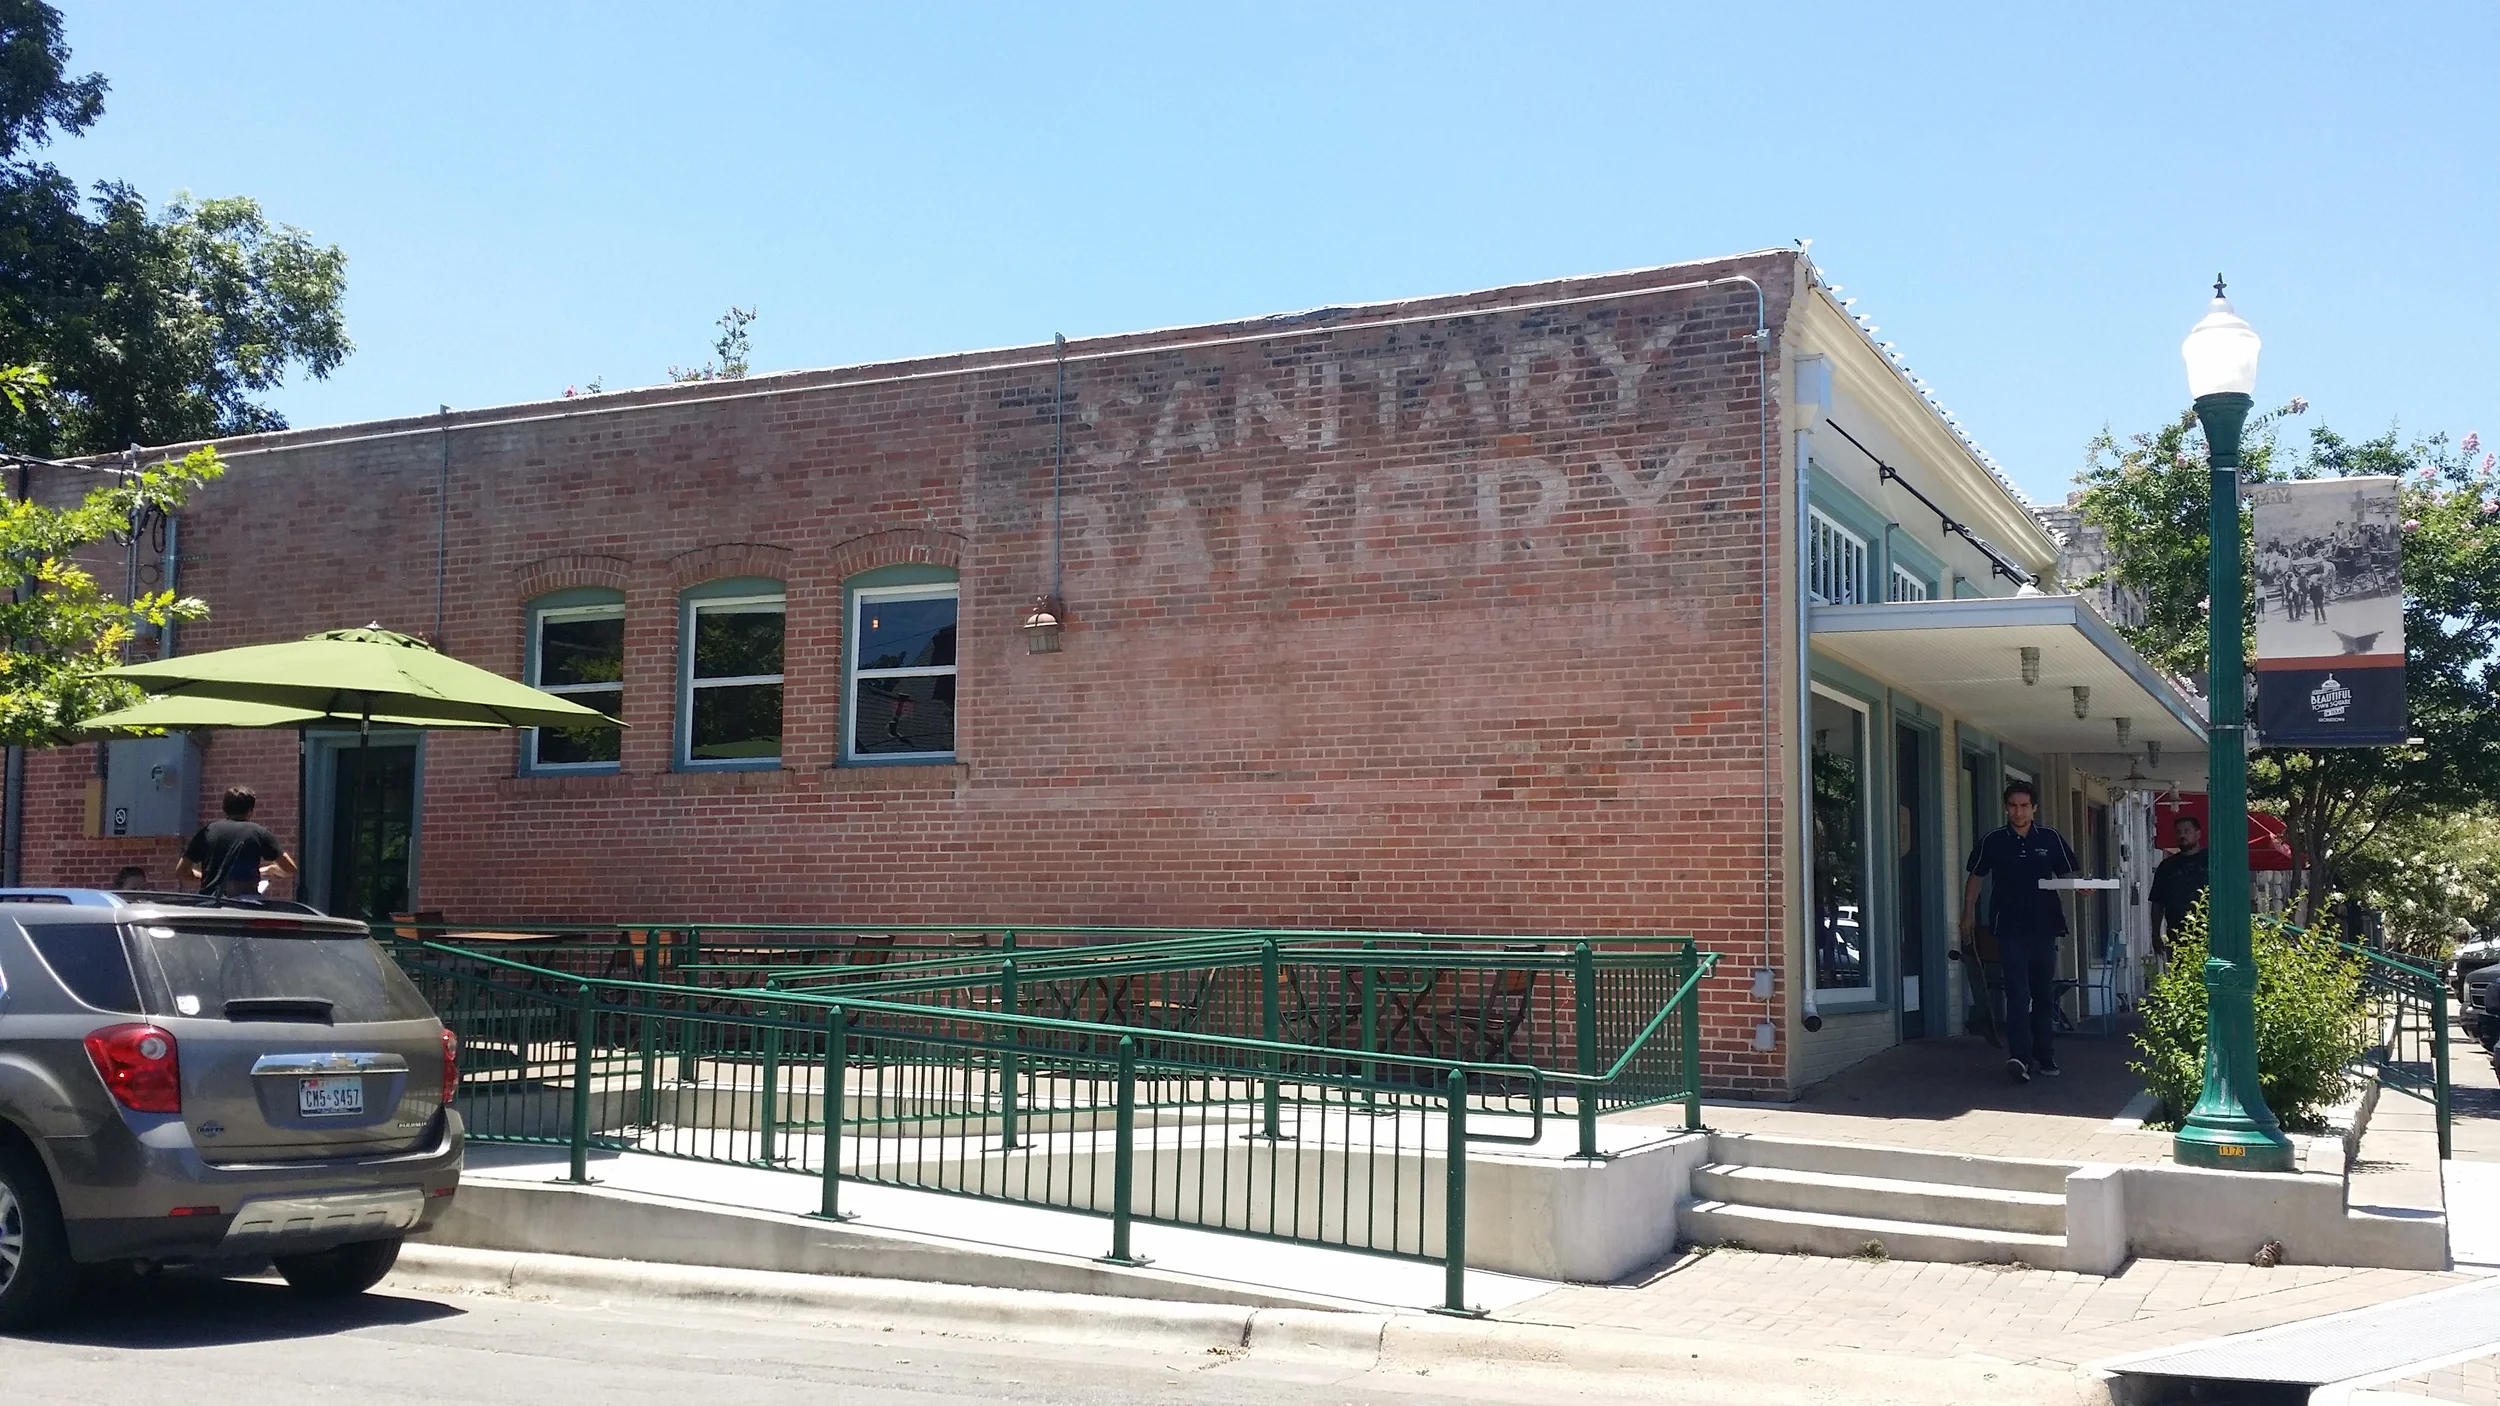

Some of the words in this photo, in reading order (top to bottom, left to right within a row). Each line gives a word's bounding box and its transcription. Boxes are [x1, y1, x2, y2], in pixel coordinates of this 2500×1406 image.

[1076, 322, 1686, 468] SANITARY
[1039, 442, 1708, 597] BAKERY
[2311, 690, 2352, 704] BEAUTIFUL
[2220, 1146, 2244, 1155] 1173
